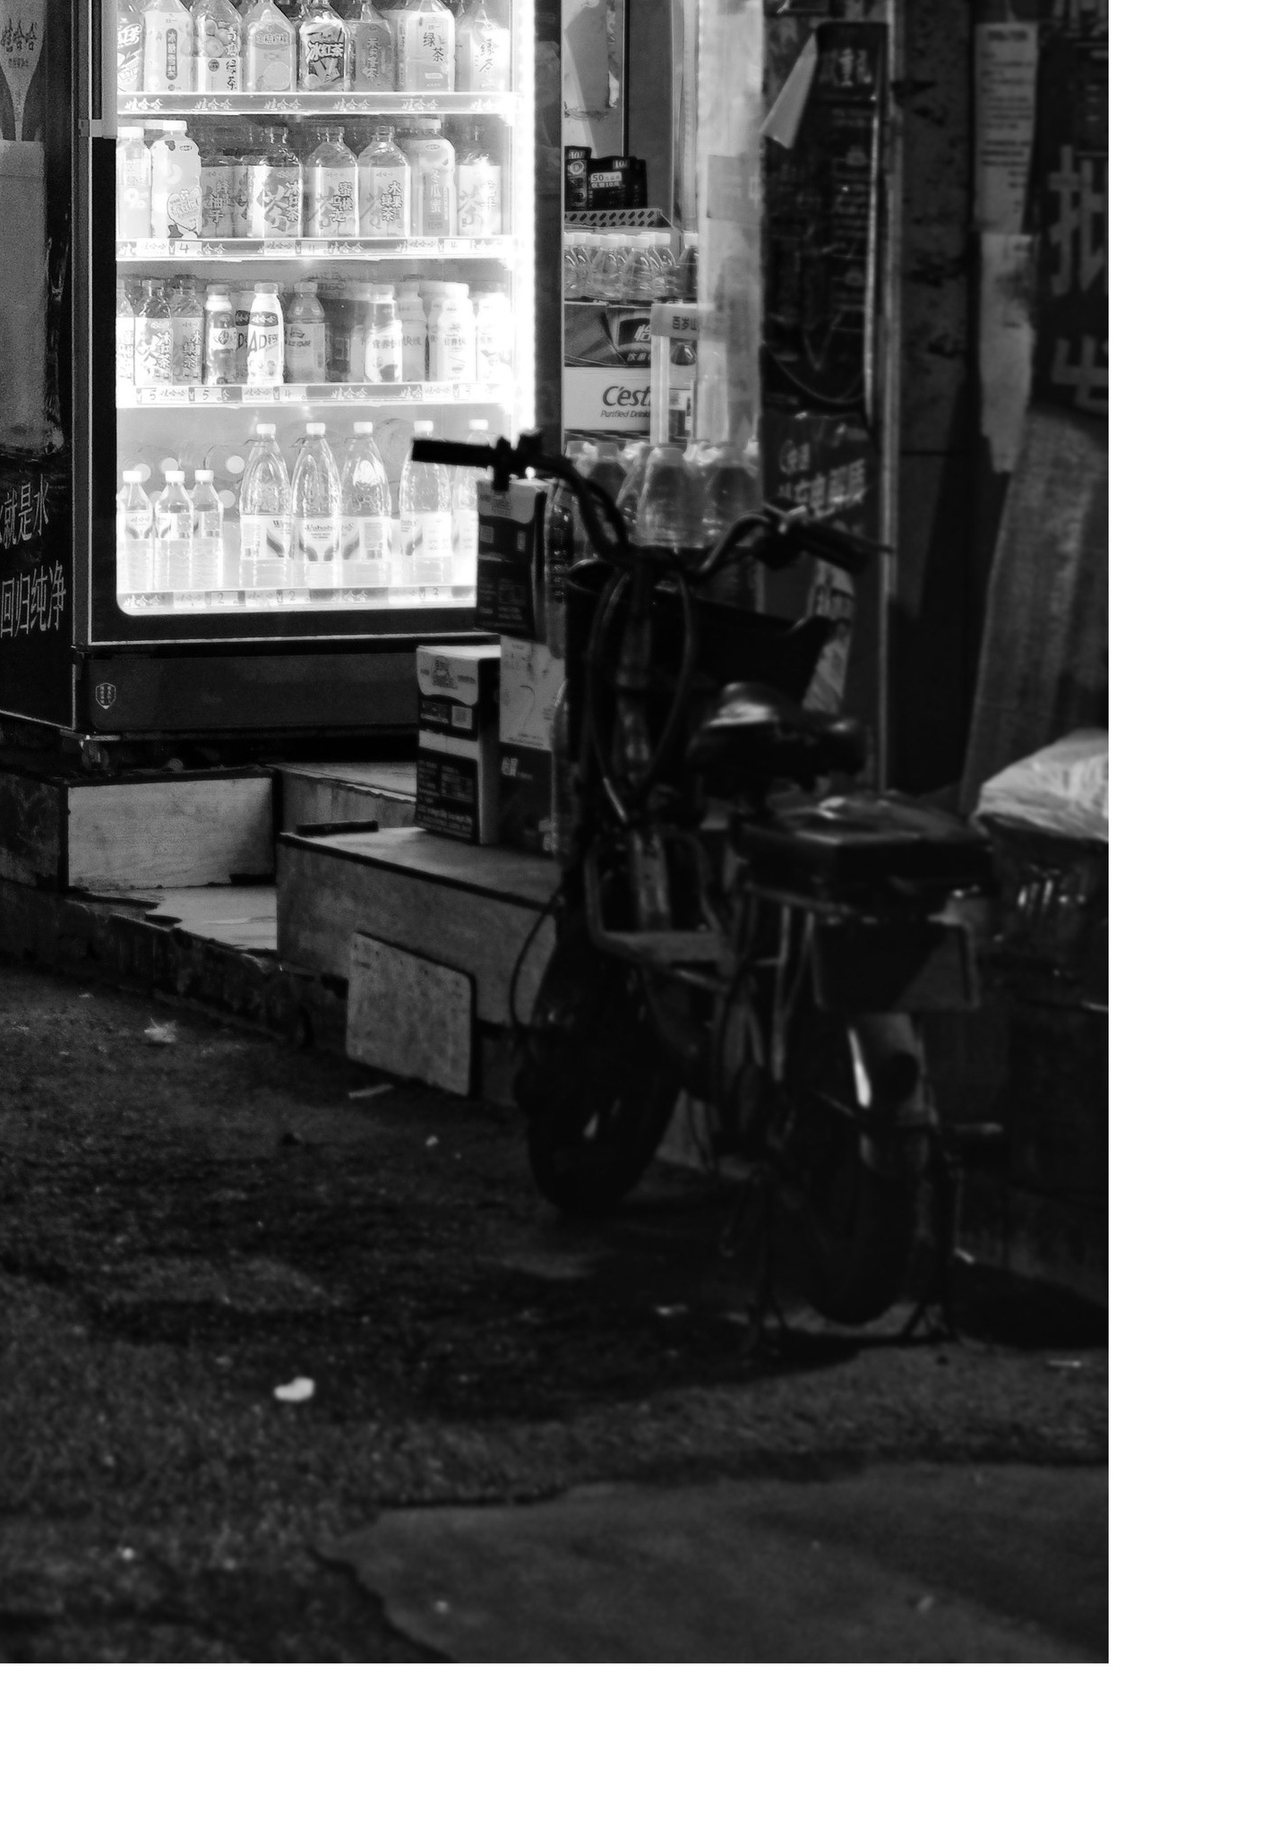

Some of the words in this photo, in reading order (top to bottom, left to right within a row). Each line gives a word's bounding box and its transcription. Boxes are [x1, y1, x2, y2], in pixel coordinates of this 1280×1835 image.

[306, 40, 344, 61] 冰红茶
[423, 32, 446, 62] 绿茶
[202, 389, 210, 401] 5
[602, 384, 652, 408] C'est
[289, 590, 296, 602] 2
